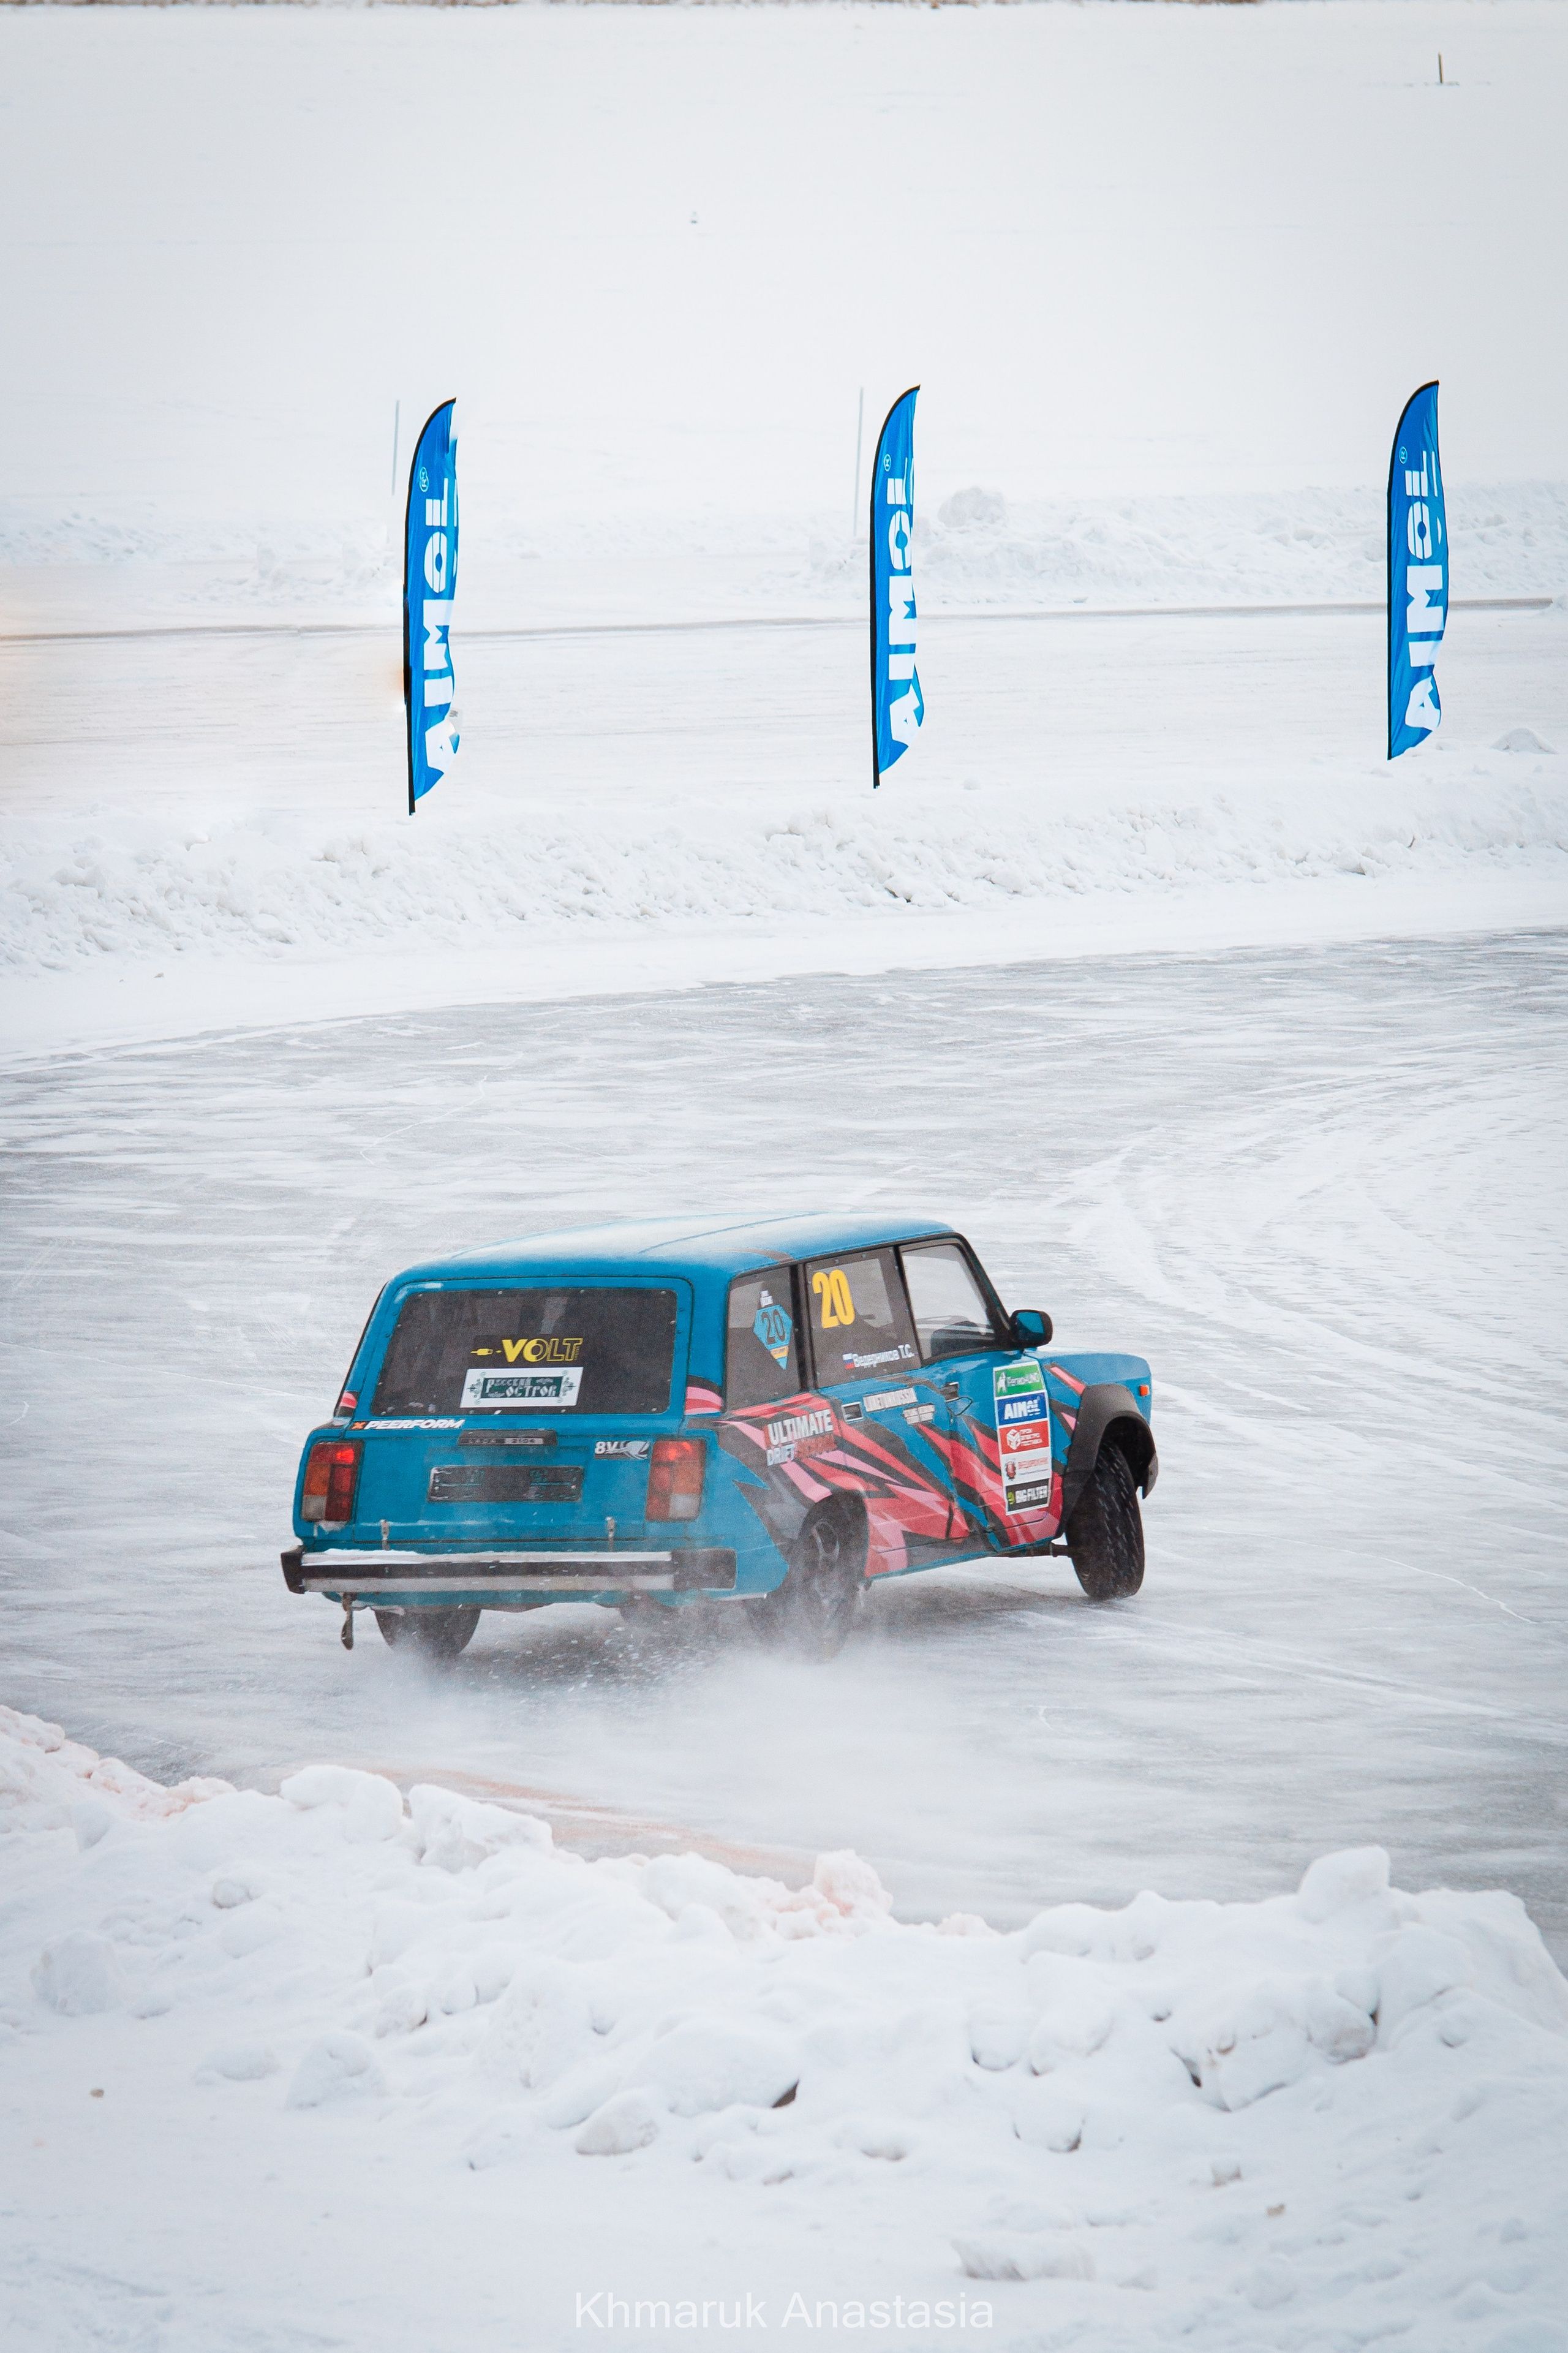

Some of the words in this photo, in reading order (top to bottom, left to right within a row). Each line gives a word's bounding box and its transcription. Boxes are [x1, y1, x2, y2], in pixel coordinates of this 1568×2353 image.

[887, 457, 920, 747] AIMOL
[1404, 450, 1444, 733] AIMOL
[423, 477, 459, 774] AIMOL
[812, 1269, 855, 1329] 20
[501, 1338, 584, 1362] VOLT
[761, 1309, 786, 1345] 20
[767, 1408, 834, 1446] ULTIMATE
[1004, 1399, 1041, 1420] AIMOL
